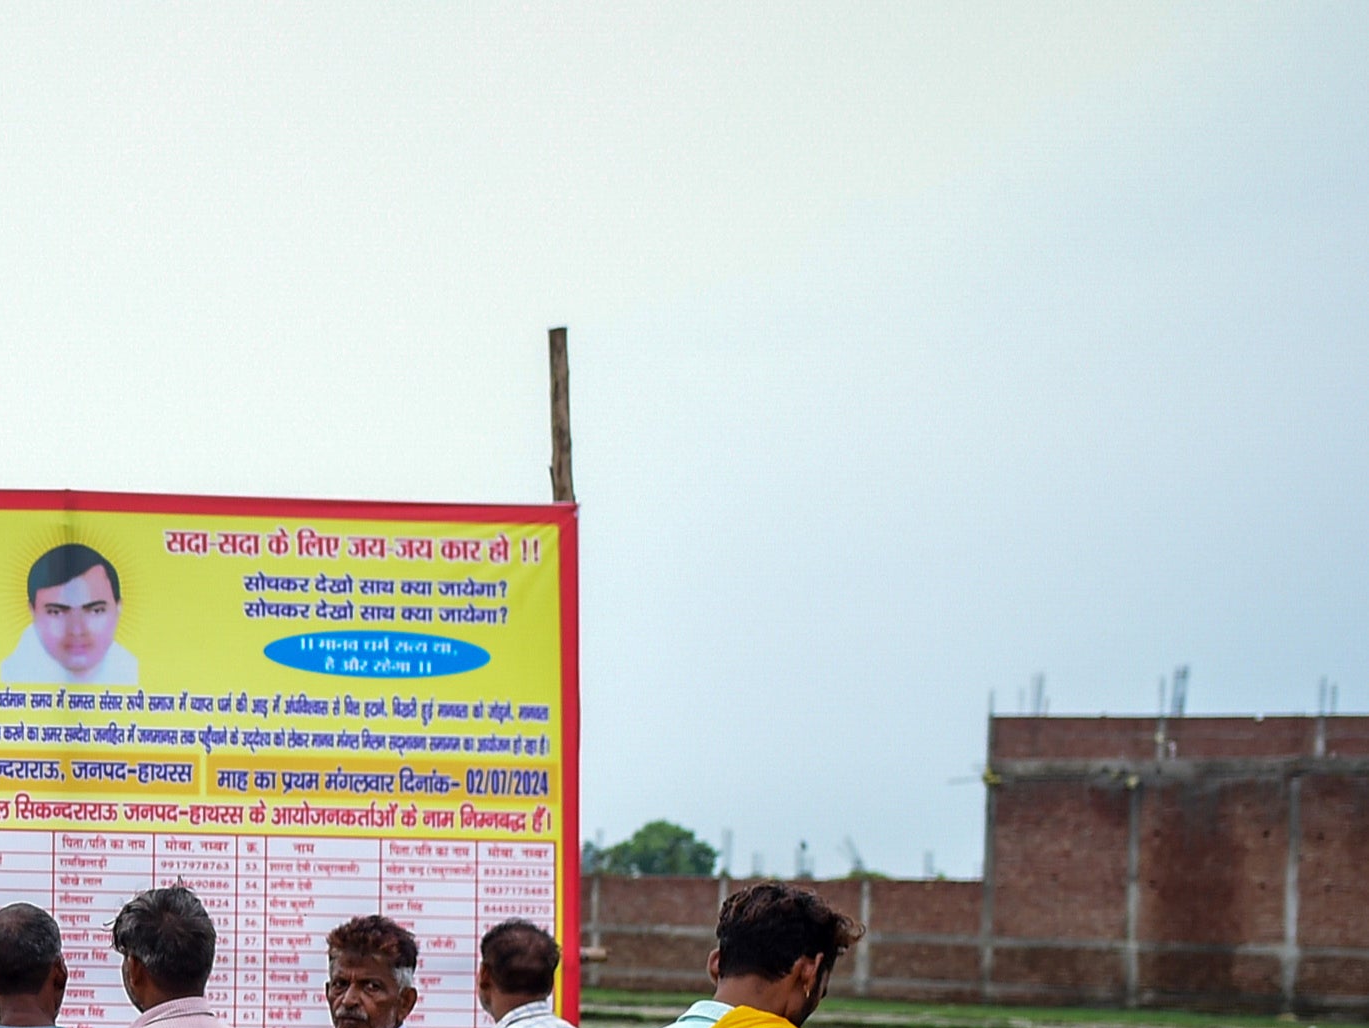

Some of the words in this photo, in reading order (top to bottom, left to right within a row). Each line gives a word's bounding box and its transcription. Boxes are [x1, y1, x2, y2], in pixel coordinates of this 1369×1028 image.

[166, 532, 258, 555] सदा-सदा
[268, 528, 288, 553] के
[297, 529, 339, 556] लिए
[348, 538, 431, 558] जय-जय
[441, 540, 480, 560] कार
[489, 534, 508, 561] हो
[244, 571, 309, 592] सोचकर
[315, 573, 352, 593] देखो
[359, 579, 393, 594] साथ
[401, 581, 431, 595] क्या
[438, 578, 506, 597] जायेगा?
[245, 597, 309, 618] सोचकर
[315, 599, 353, 619] देखो
[360, 605, 394, 620] साथ
[401, 607, 432, 621] क्या
[439, 603, 507, 623] जायेगा?
[319, 638, 358, 651] मानव
[71, 761, 191, 782] जनपद-हाथरस
[217, 770, 248, 791] माह
[254, 771, 275, 789] का
[281, 772, 319, 793] प्रथम
[325, 767, 394, 792] मंगलवार
[466, 769, 547, 795] 02/07/2024
[15, 794, 117, 820] सिकन्दराराऊ
[123, 804, 243, 824] जनपद-हाथरस
[249, 800, 265, 822] के
[271, 801, 397, 826] आयोजनकर्ताओं
[401, 804, 416, 826] के
[423, 811, 453, 827] नाम
[110, 838, 123, 850] का
[128, 839, 145, 851] नाम
